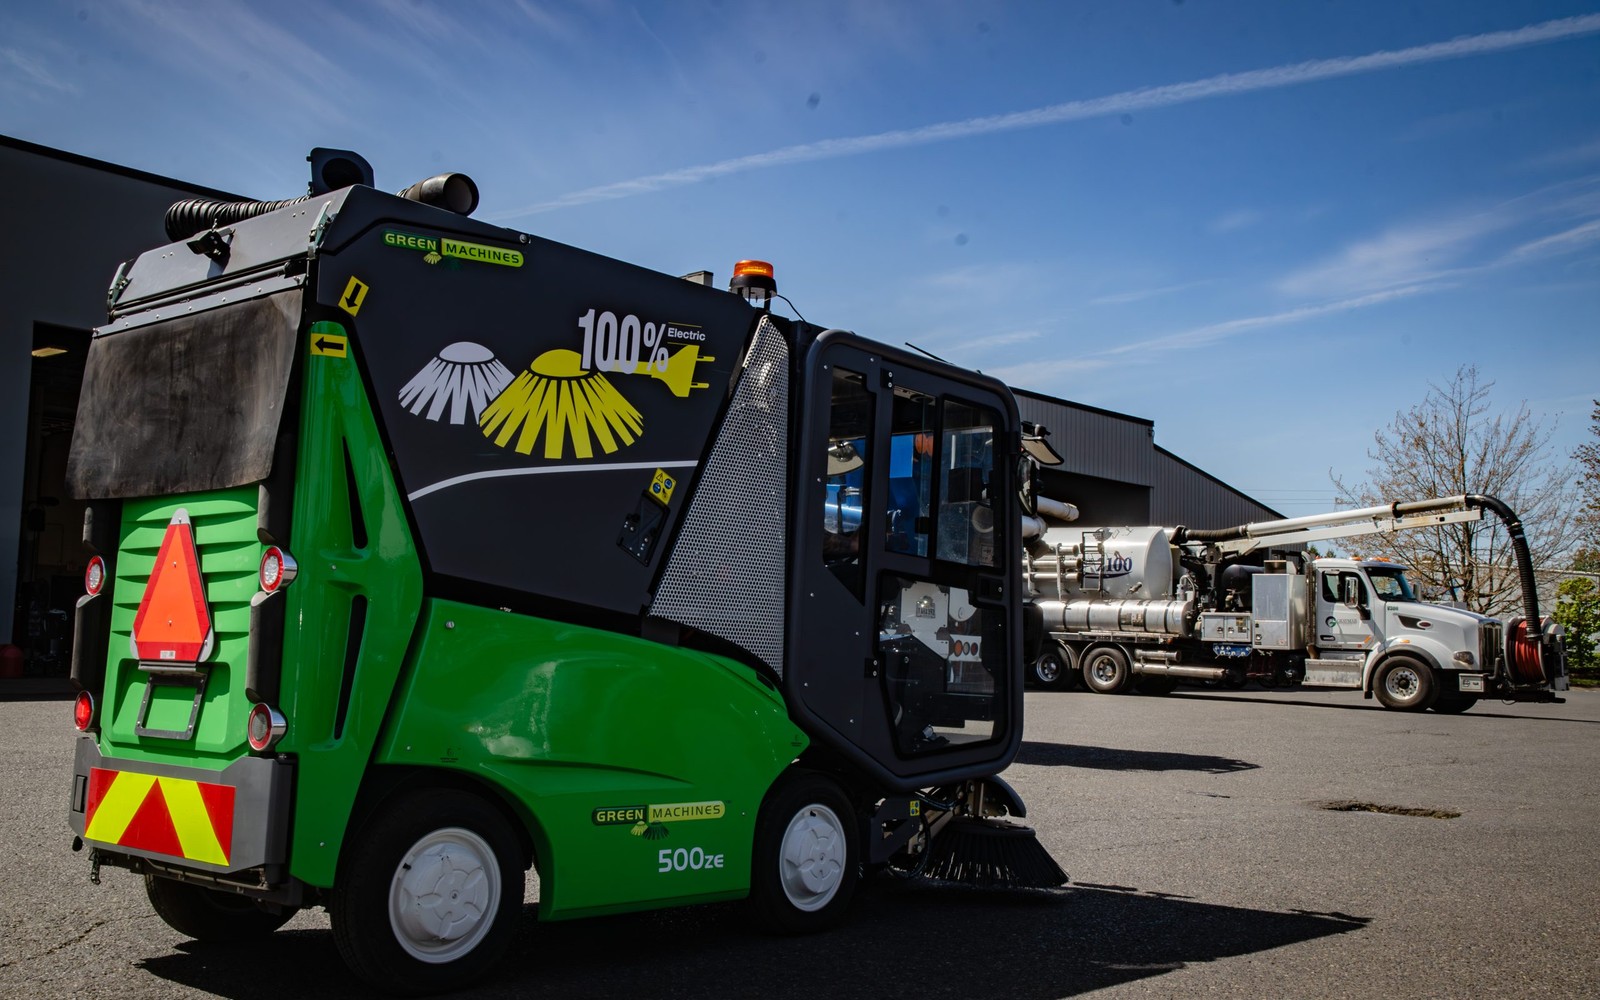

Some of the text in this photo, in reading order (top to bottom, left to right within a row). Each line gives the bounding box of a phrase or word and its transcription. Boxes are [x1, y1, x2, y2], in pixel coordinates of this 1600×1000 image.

[385, 233, 520, 264] GREEN MACHINES
[578, 309, 668, 374] 100%
[667, 327, 706, 341] Electric
[597, 805, 720, 822] GREEN MACHINES
